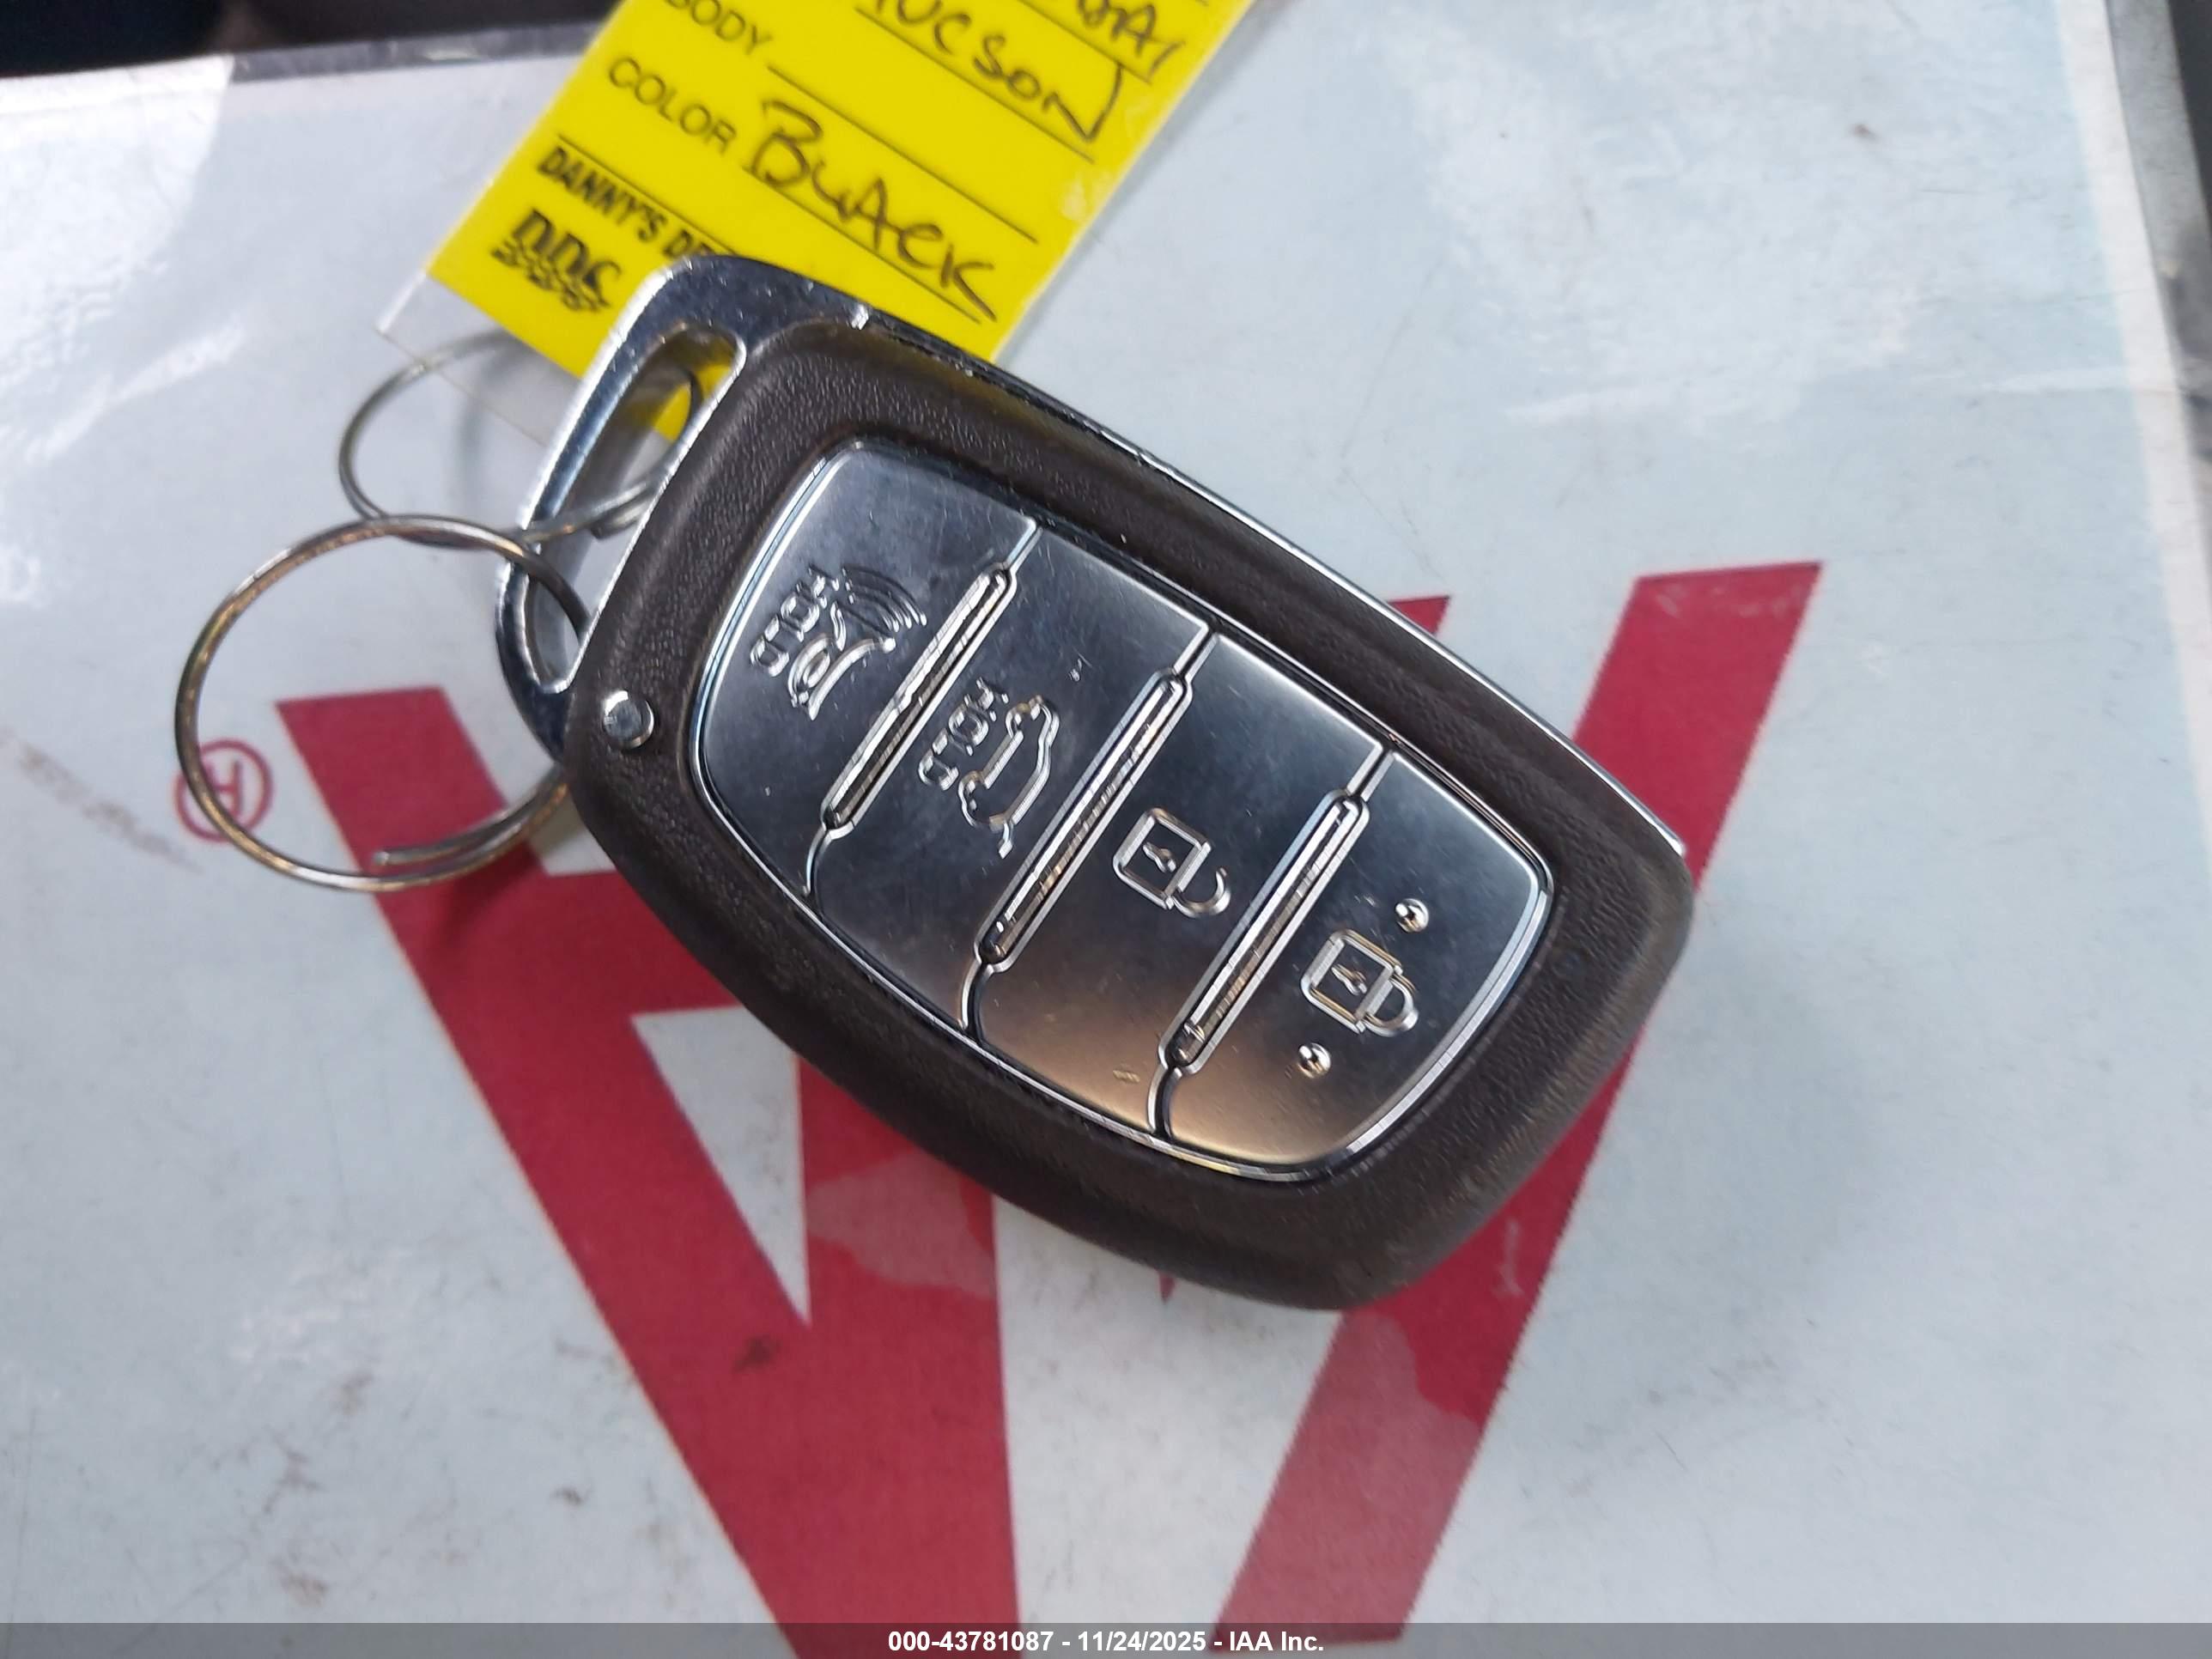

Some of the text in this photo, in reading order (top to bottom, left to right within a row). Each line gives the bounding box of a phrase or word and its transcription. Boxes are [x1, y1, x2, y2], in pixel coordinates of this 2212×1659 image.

[609, 56, 737, 155] COLOR
[876, 0, 1123, 143] UCSON
[537, 145, 668, 243] DANNY'S
[750, 564, 840, 678] HOLD
[918, 676, 1009, 791] HOLD
